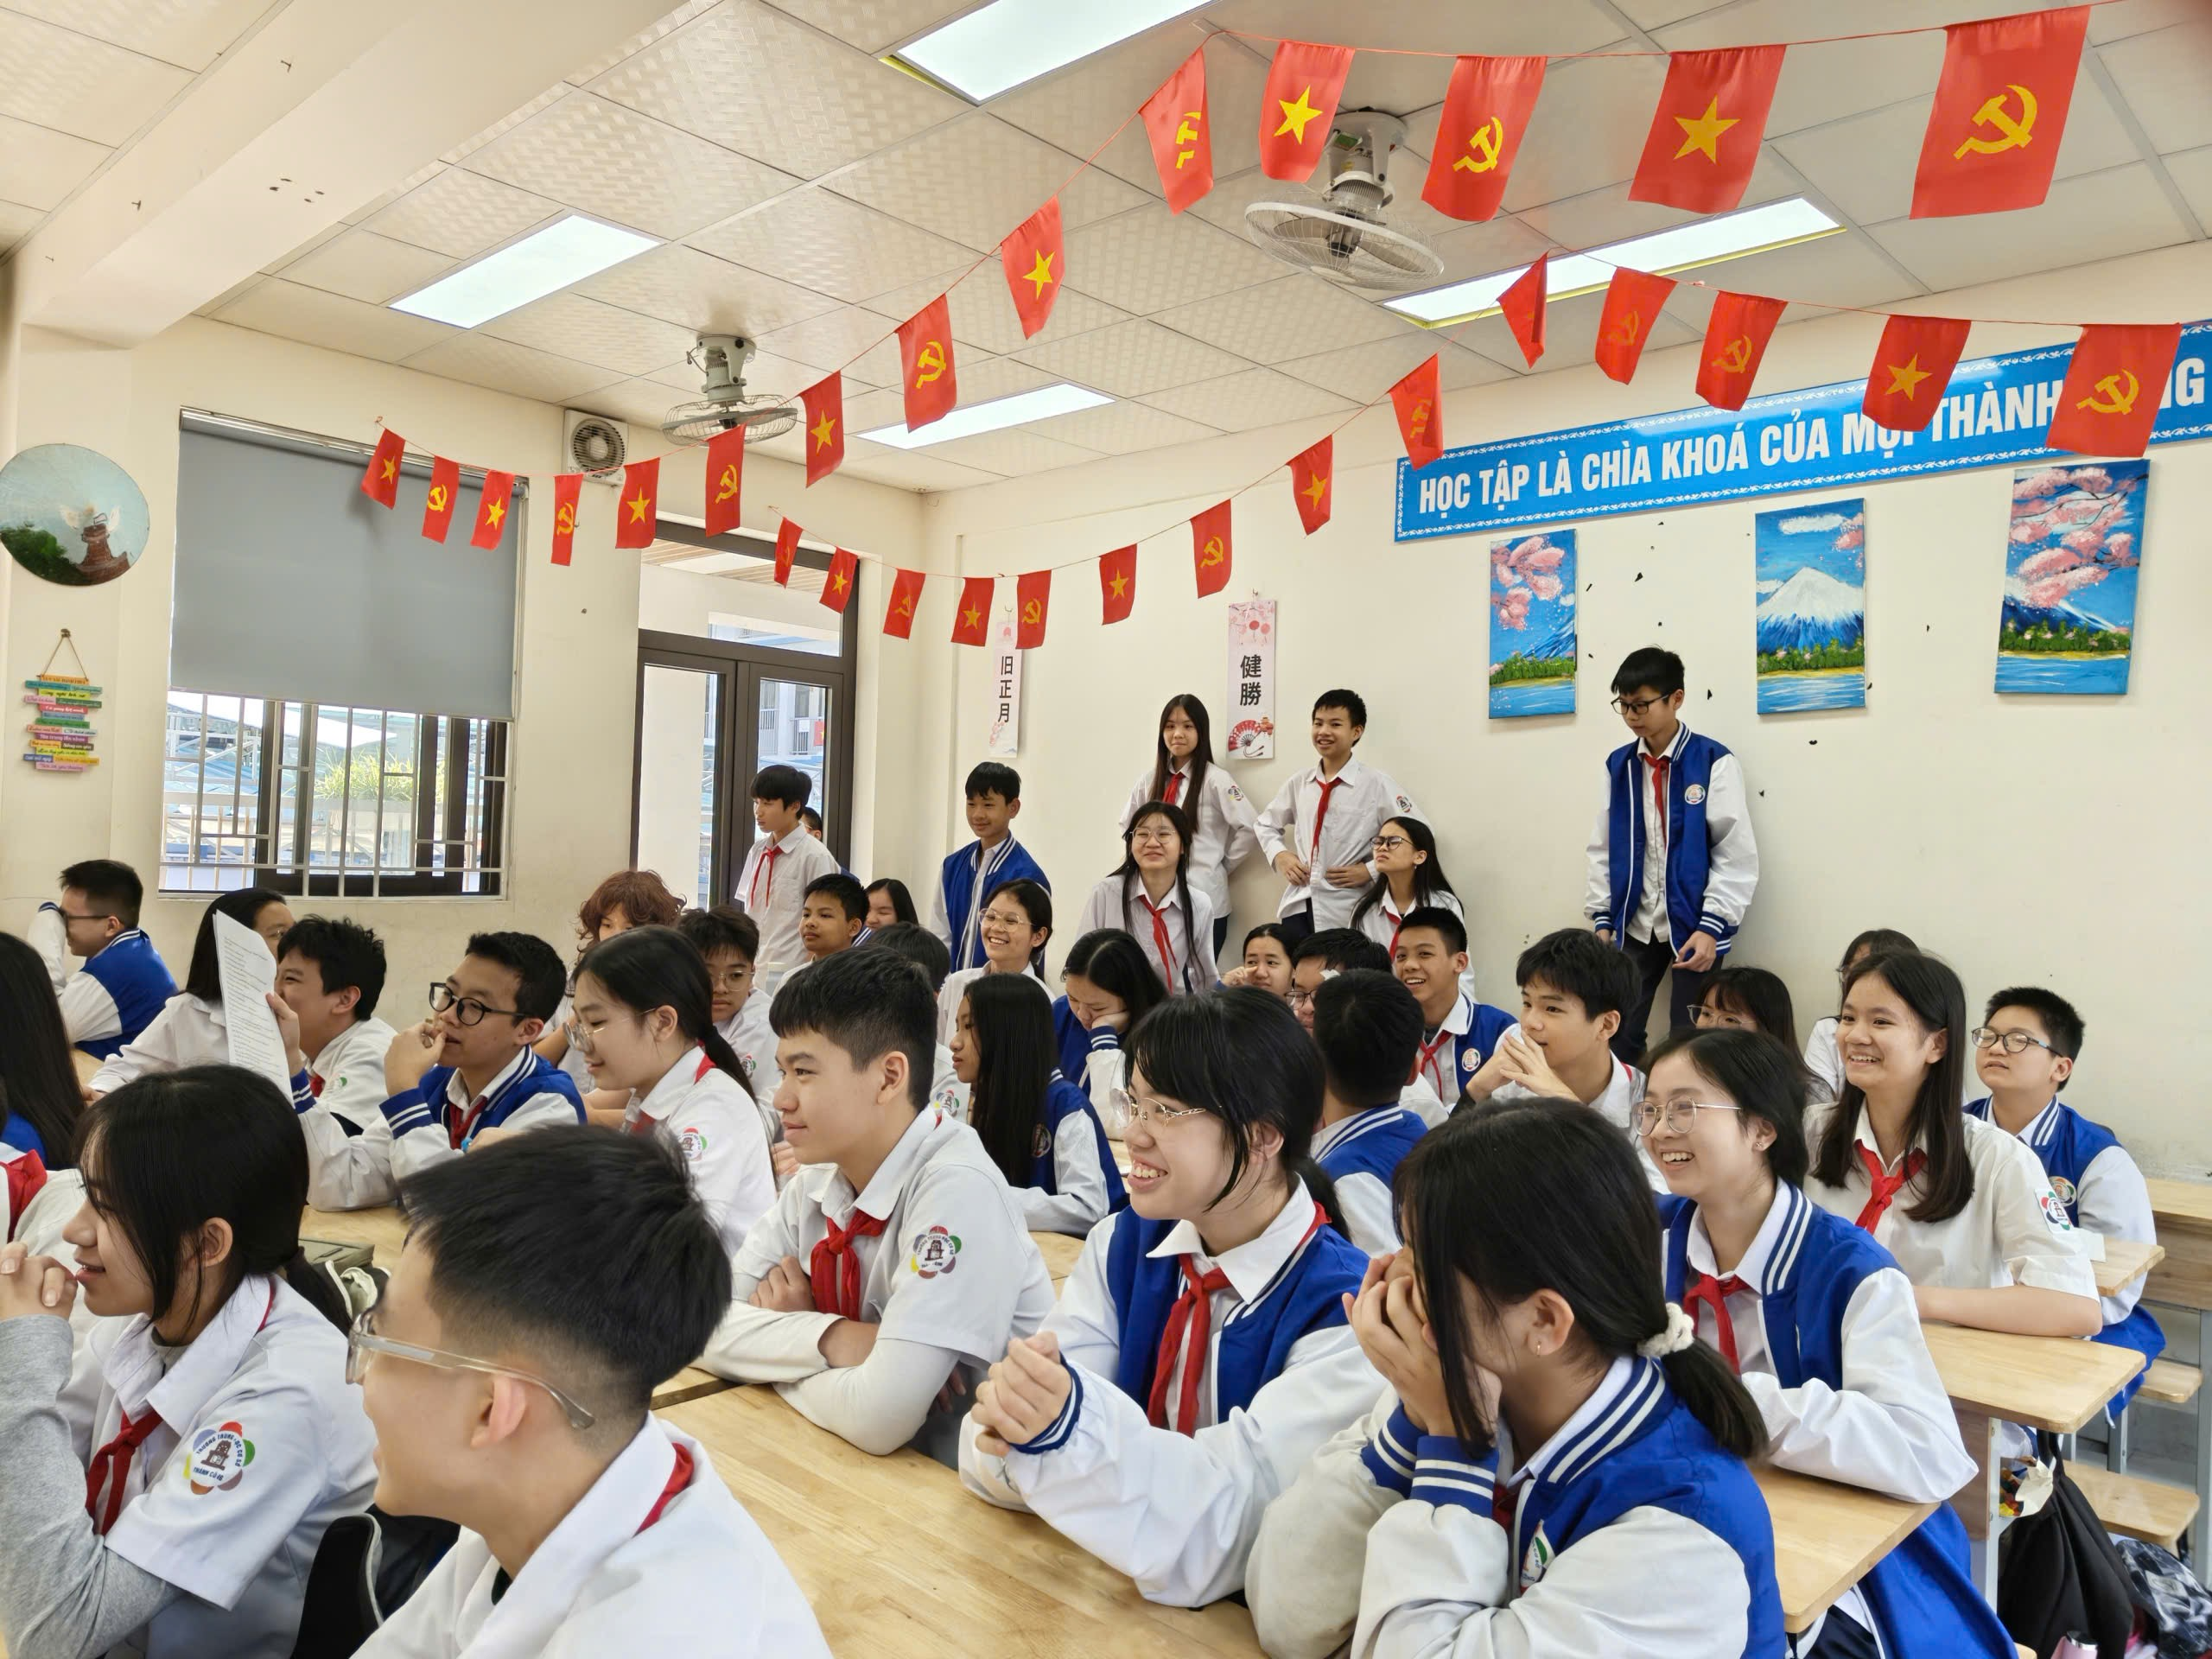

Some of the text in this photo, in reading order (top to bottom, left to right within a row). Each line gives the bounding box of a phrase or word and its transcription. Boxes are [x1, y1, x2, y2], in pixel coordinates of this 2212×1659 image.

[1419, 473, 1471, 518] HỌC
[1478, 459, 1530, 512] TẬP
[1538, 450, 1573, 498] LÀ
[1581, 441, 1652, 492] CHÌA
[1662, 422, 1750, 481] KHOÁ
[1759, 408, 1830, 467] CỦA
[1931, 380, 2064, 442] THÀNH
[997, 655, 1014, 724] 旧正月
[1239, 654, 1262, 707] 健勝
